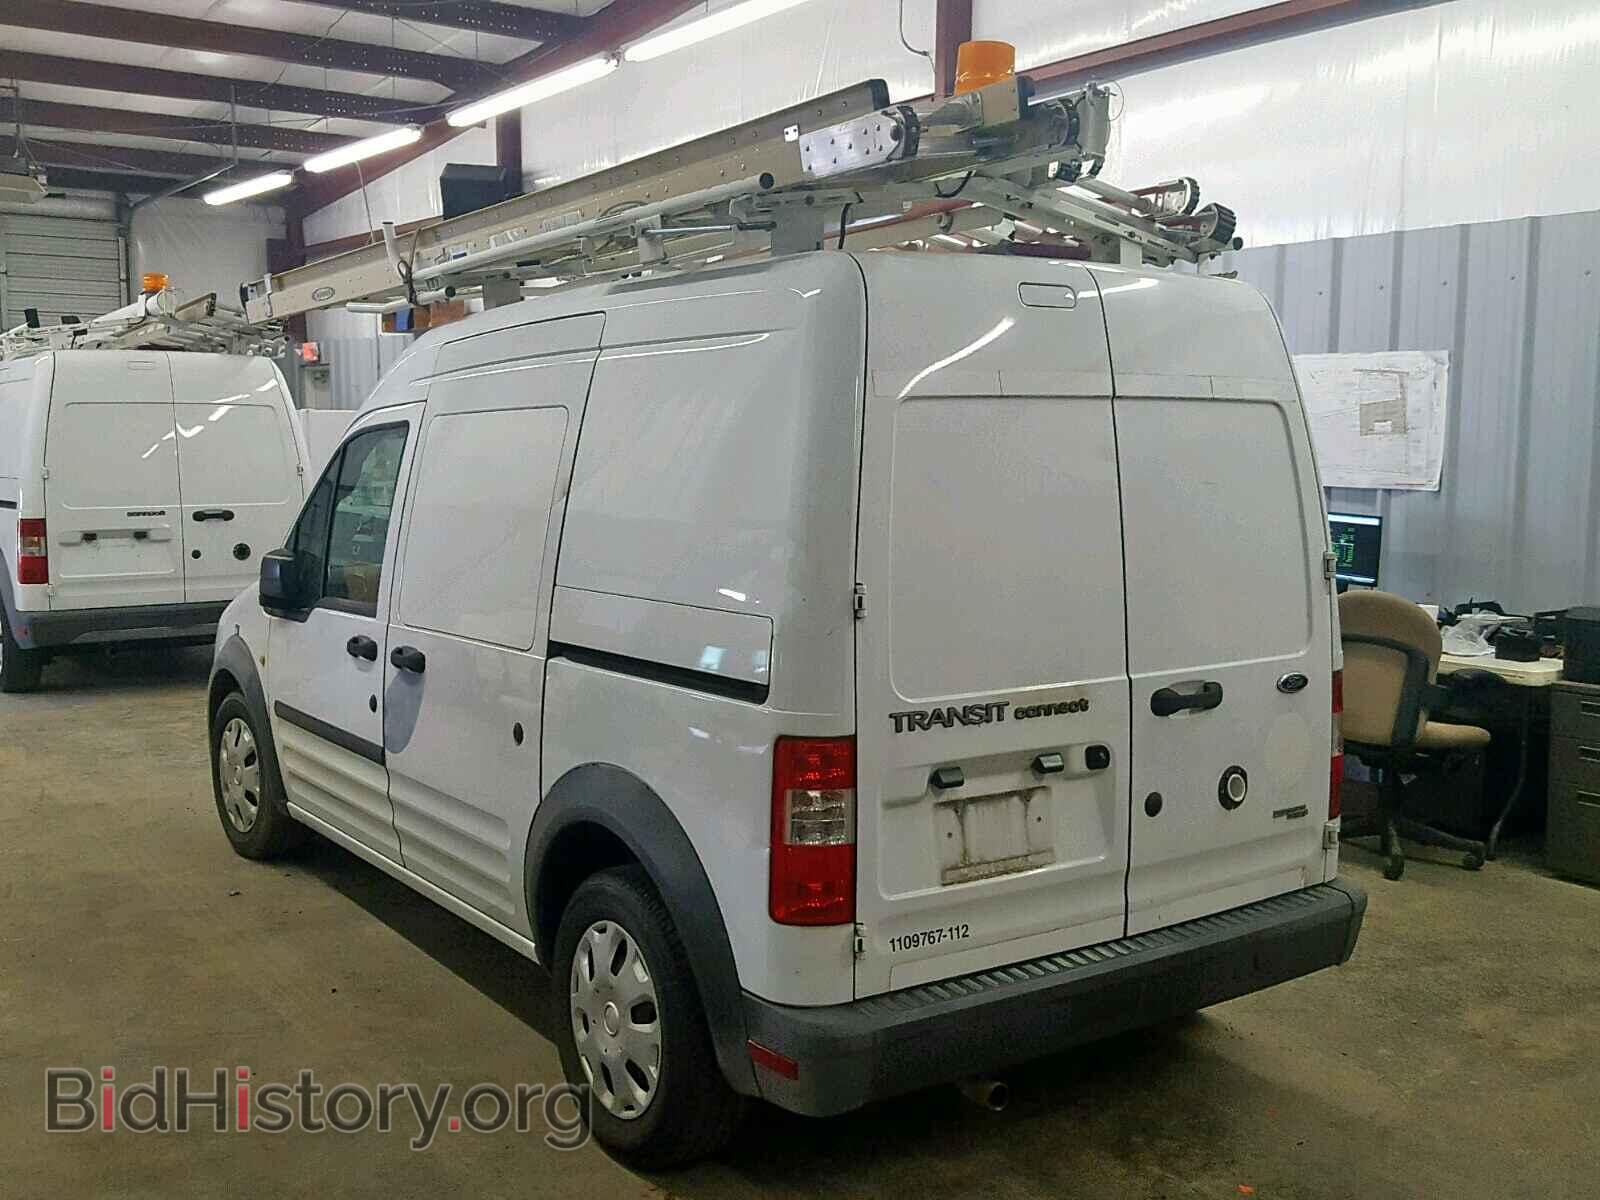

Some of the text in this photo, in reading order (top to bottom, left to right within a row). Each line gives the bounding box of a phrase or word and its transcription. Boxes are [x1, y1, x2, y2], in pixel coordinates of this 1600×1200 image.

[889, 698, 1090, 733] TRANSIT connect
[889, 924, 970, 953] 1109767-112
